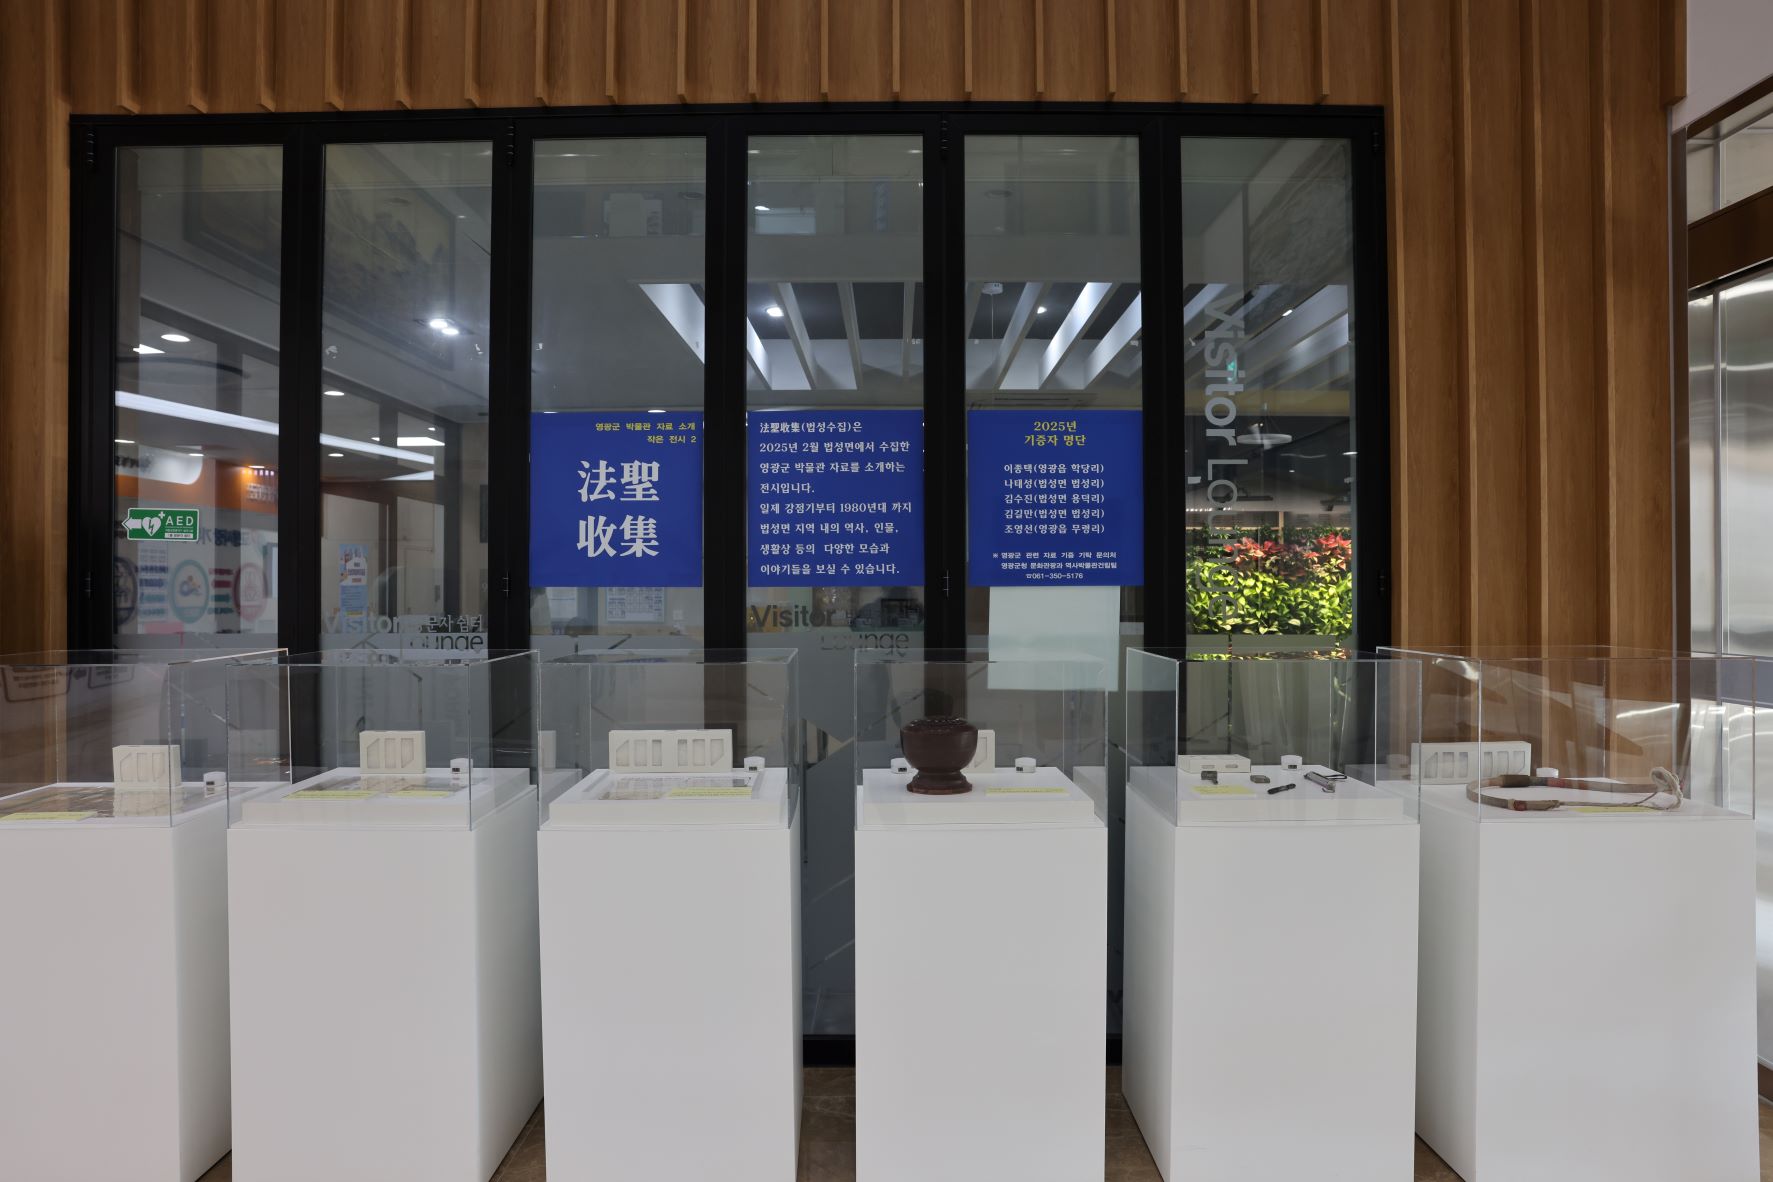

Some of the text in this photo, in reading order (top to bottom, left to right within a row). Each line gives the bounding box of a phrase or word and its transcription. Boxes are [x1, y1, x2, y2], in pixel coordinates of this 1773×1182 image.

[596, 423, 620, 431] 영광군
[1034, 421, 1076, 432] 2025년
[1025, 435, 1086, 446] 기증자 명단
[760, 441, 910, 452] 2025년 2월 법성면에서 수집한
[1198, 286, 1249, 620] Visitor Lounge
[760, 462, 905, 473] 영광군 박물관 자료를 소개하는
[1071, 464, 1103, 473] 학당리)
[578, 460, 660, 502] 法聖
[1072, 479, 1104, 488] 법성리)
[760, 483, 814, 493] 전시입니다.
[1005, 494, 1104, 504] 김수진(법성면 용덕리)
[760, 502, 911, 514] 일제 강점기부터 1980년대 까지
[1072, 509, 1104, 519] 법성리)
[165, 515, 194, 526] AED
[761, 524, 790, 534] 법성면
[796, 523, 814, 534] 지역
[820, 523, 839, 533] 내의
[577, 515, 659, 557] 收集
[760, 543, 890, 555] 생활상 등의 다양한 모습과
[761, 564, 899, 575] 이야기들을 보실 수 있습니다.
[751, 604, 836, 627] Visitor
[325, 612, 400, 633] Visitor
[456, 614, 482, 633] 쉼터
